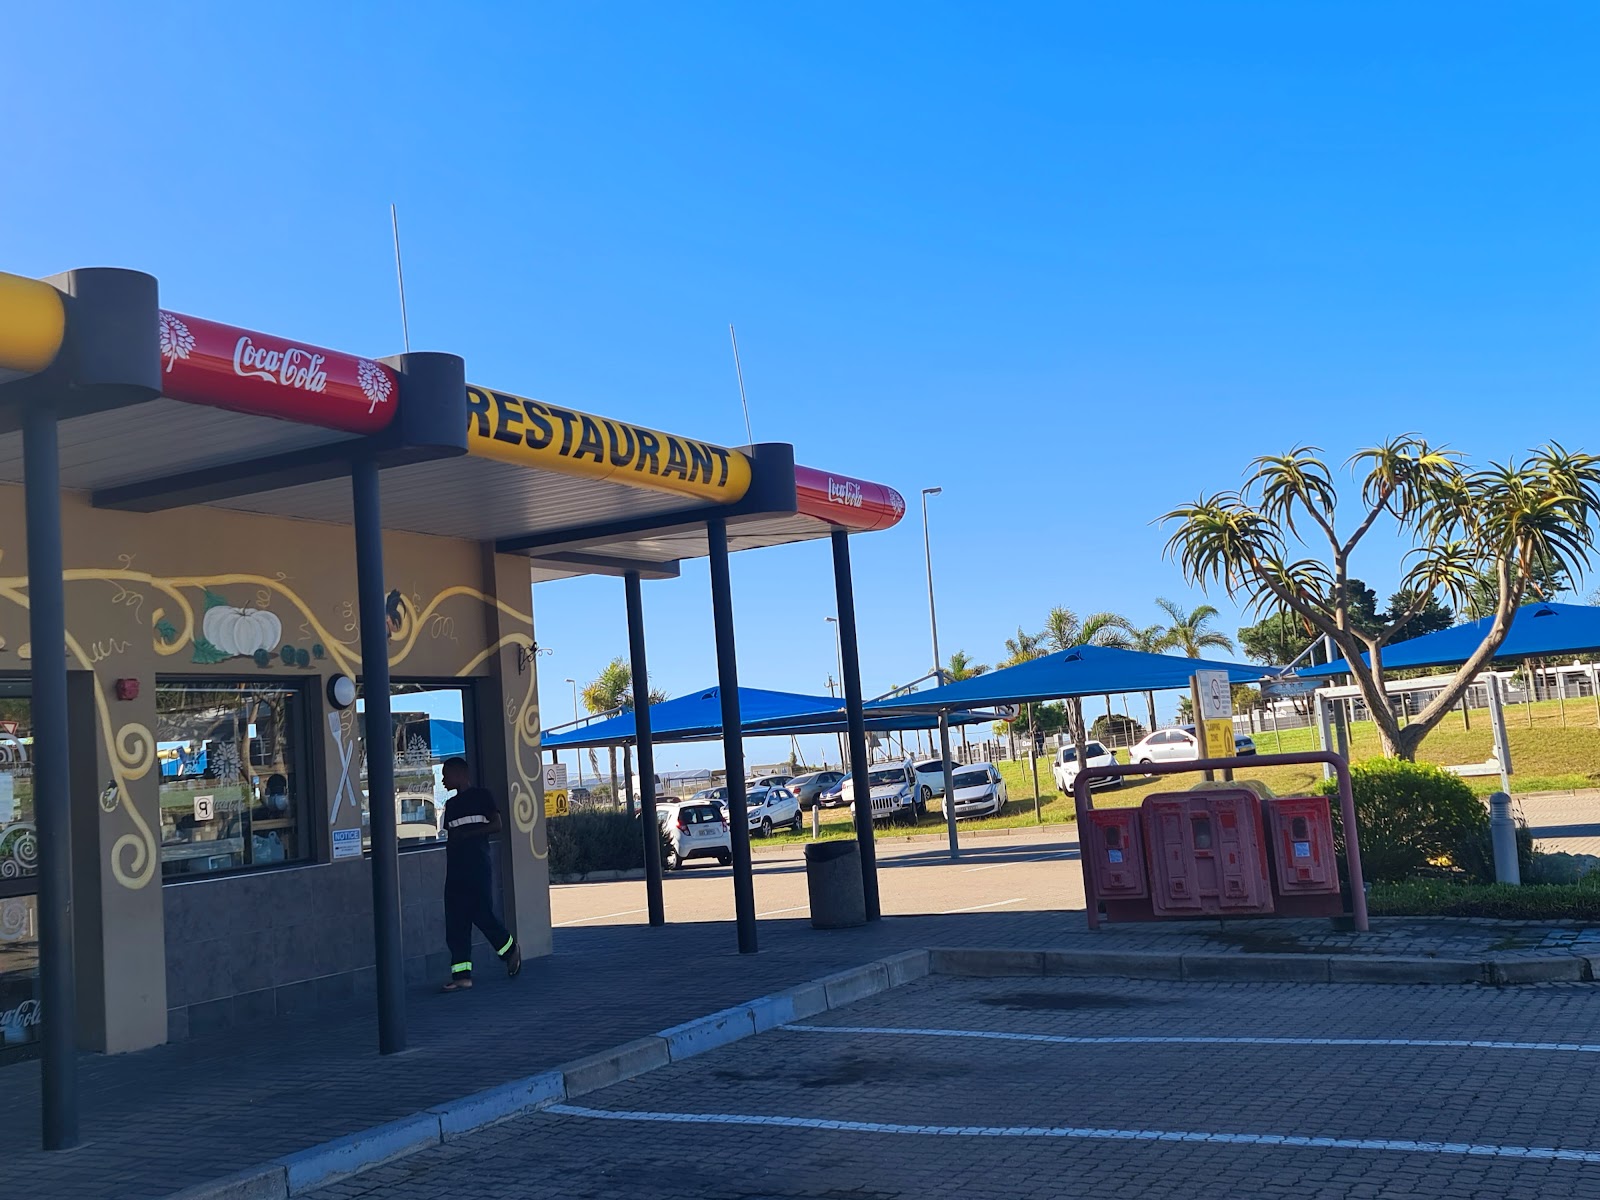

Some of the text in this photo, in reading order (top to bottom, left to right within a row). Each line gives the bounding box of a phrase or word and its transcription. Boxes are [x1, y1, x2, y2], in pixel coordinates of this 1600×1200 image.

[233, 336, 328, 393] Coca-Cola
[466, 386, 731, 488] RESTAURANT
[828, 477, 863, 508] Coca-Cola
[334, 831, 359, 841] NOTICE
